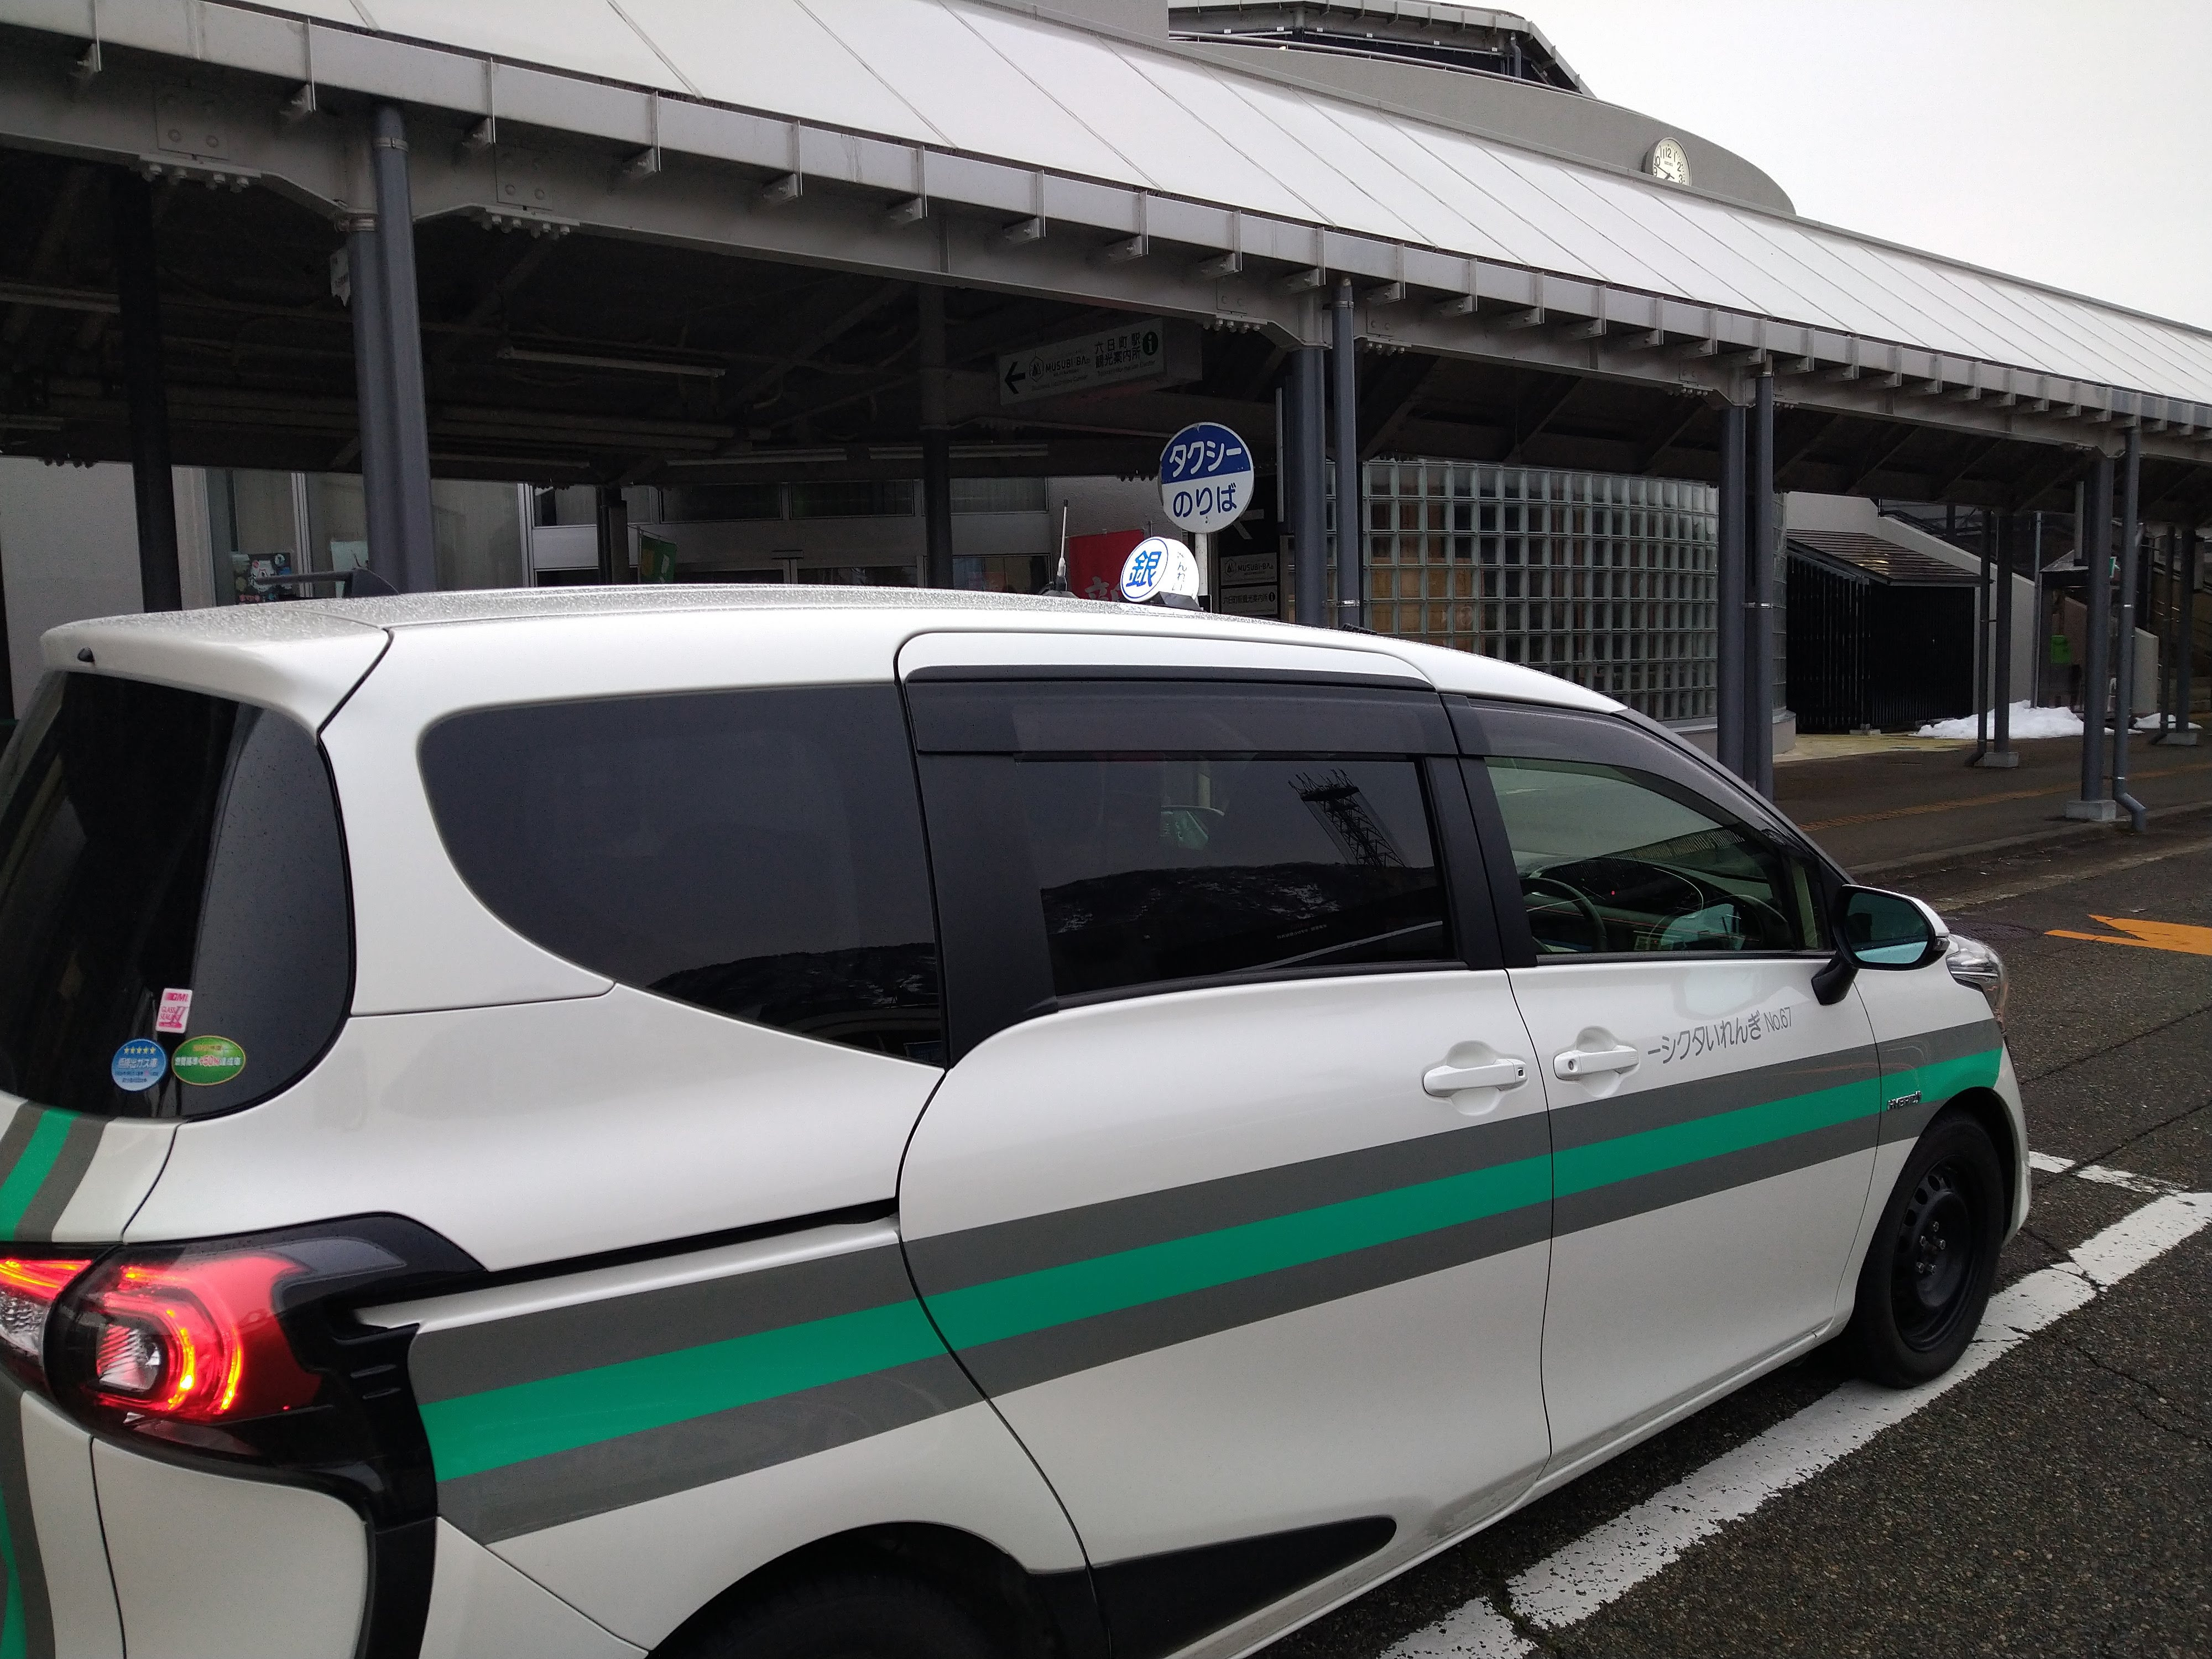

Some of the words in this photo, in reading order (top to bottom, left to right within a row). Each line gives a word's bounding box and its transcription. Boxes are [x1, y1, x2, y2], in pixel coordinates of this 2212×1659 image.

[1666, 147, 1672, 158] 12
[1677, 161, 1681, 172] 2
[1678, 174, 1683, 184] 3
[1094, 332, 1140, 354] 六日町駅
[1095, 346, 1141, 368] 観光案内所
[1170, 440, 1242, 478] タクシー
[1173, 482, 1237, 518] のりば
[1126, 550, 1162, 587] 銀
[1764, 1006, 1792, 1032] No.67
